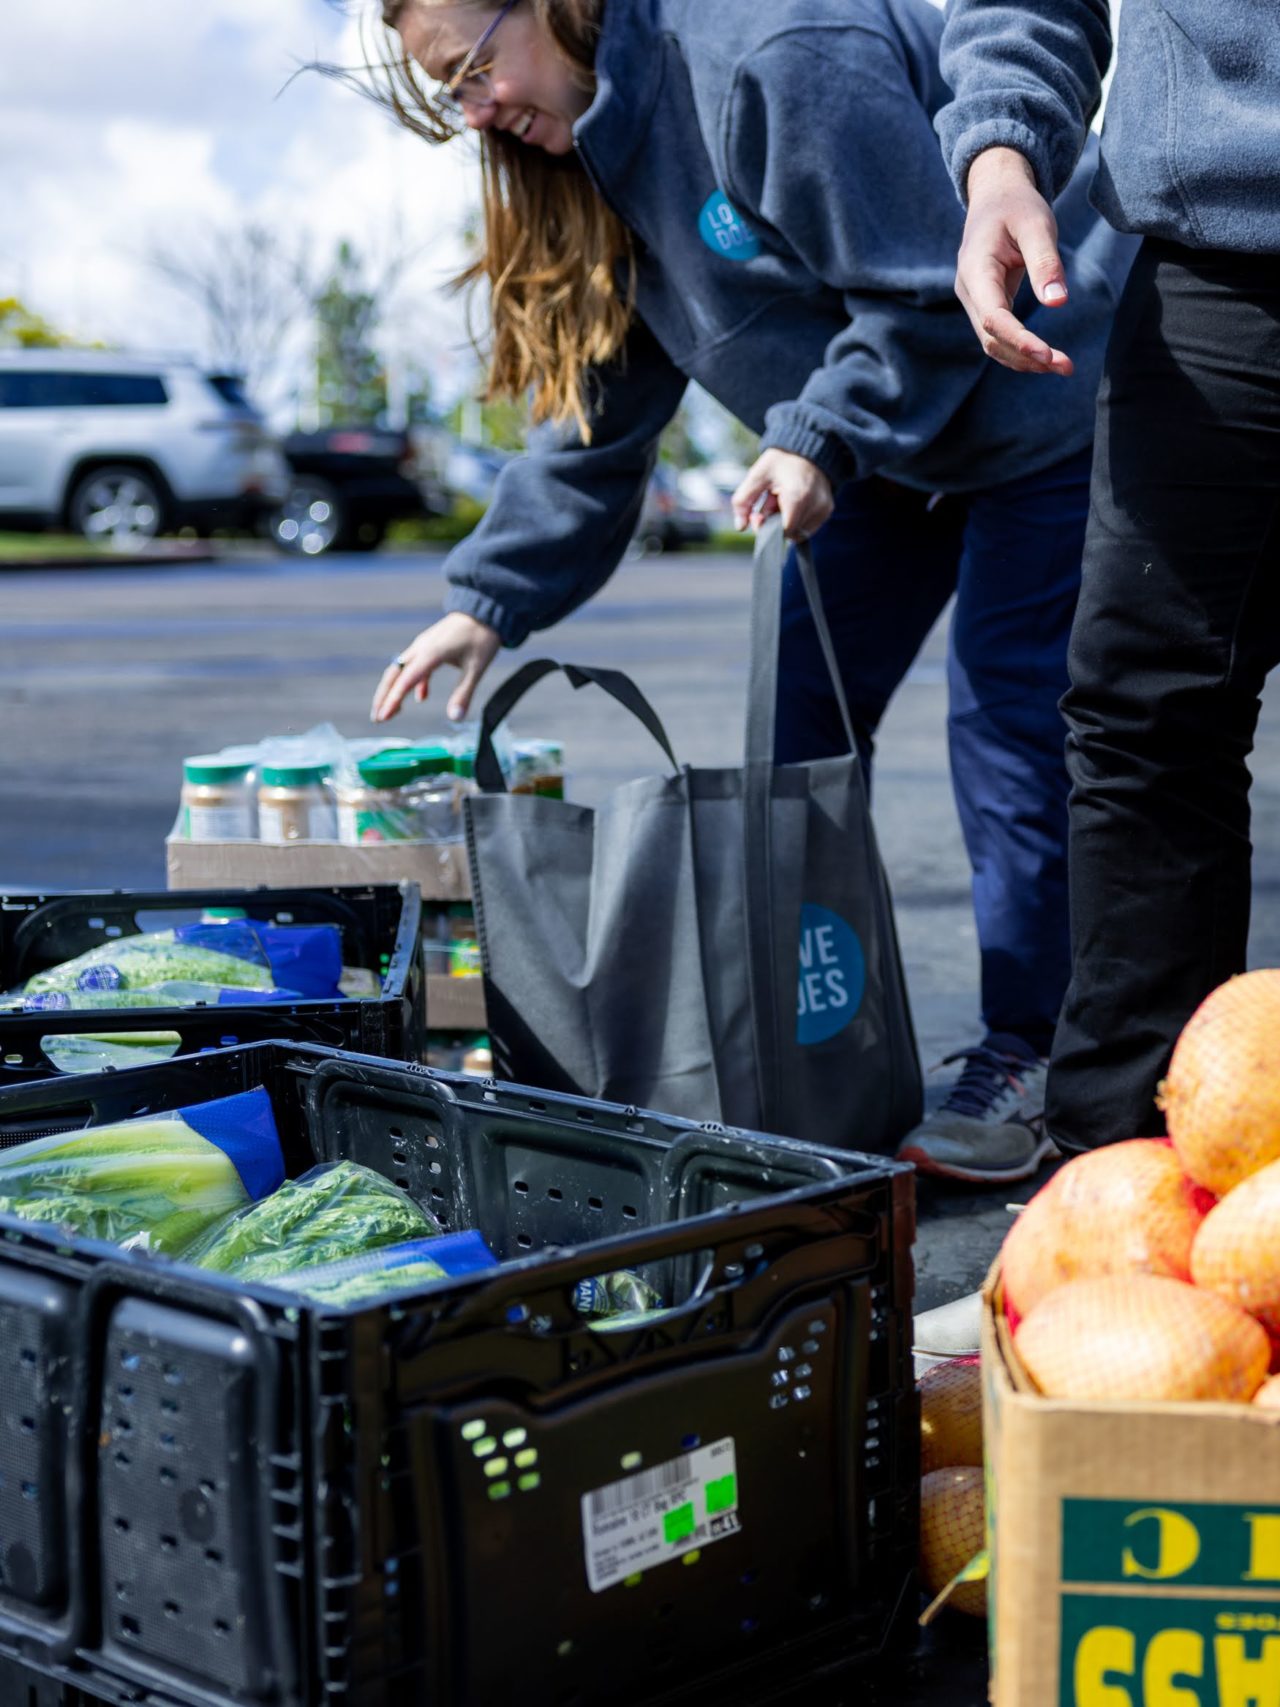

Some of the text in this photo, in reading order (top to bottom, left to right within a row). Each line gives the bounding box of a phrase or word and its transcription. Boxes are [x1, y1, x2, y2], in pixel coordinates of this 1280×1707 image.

[707, 203, 734, 229] LO
[799, 925, 839, 968] VE
[797, 968, 848, 1016] ES
